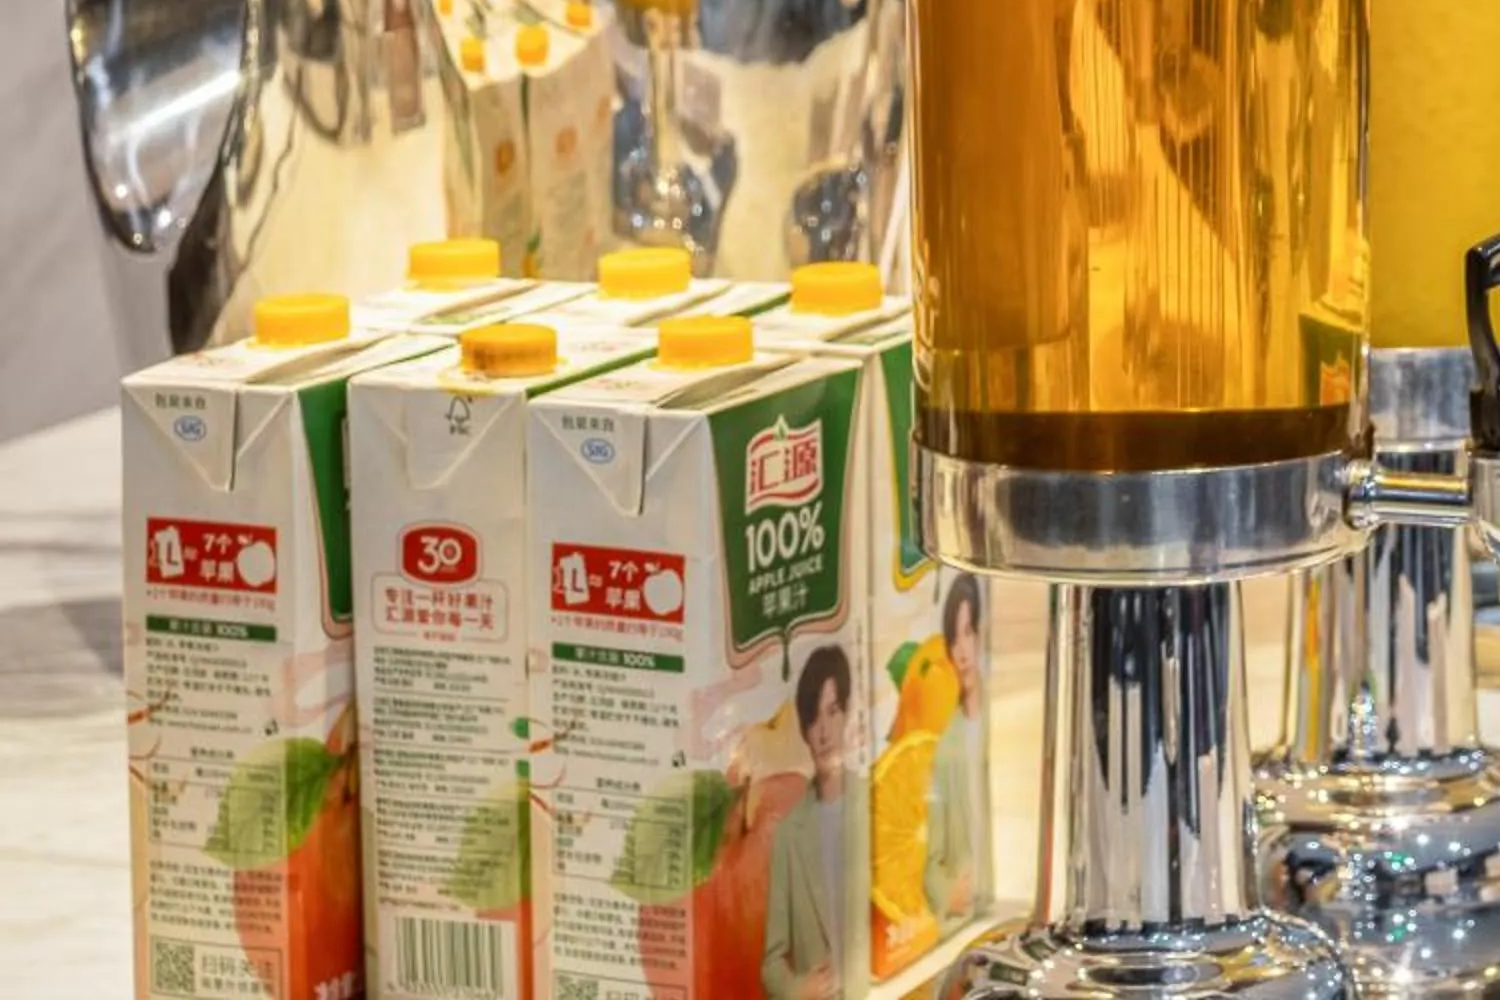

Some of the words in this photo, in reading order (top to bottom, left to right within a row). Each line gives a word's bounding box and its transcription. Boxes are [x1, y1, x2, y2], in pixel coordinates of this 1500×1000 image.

[751, 440, 817, 496] 汇源
[418, 535, 463, 573] 30
[746, 501, 826, 573] 100%
[749, 566, 786, 596] APPLE
[788, 553, 824, 583] JUICE
[605, 586, 641, 612] 苹果
[762, 581, 809, 619] 苹果汁
